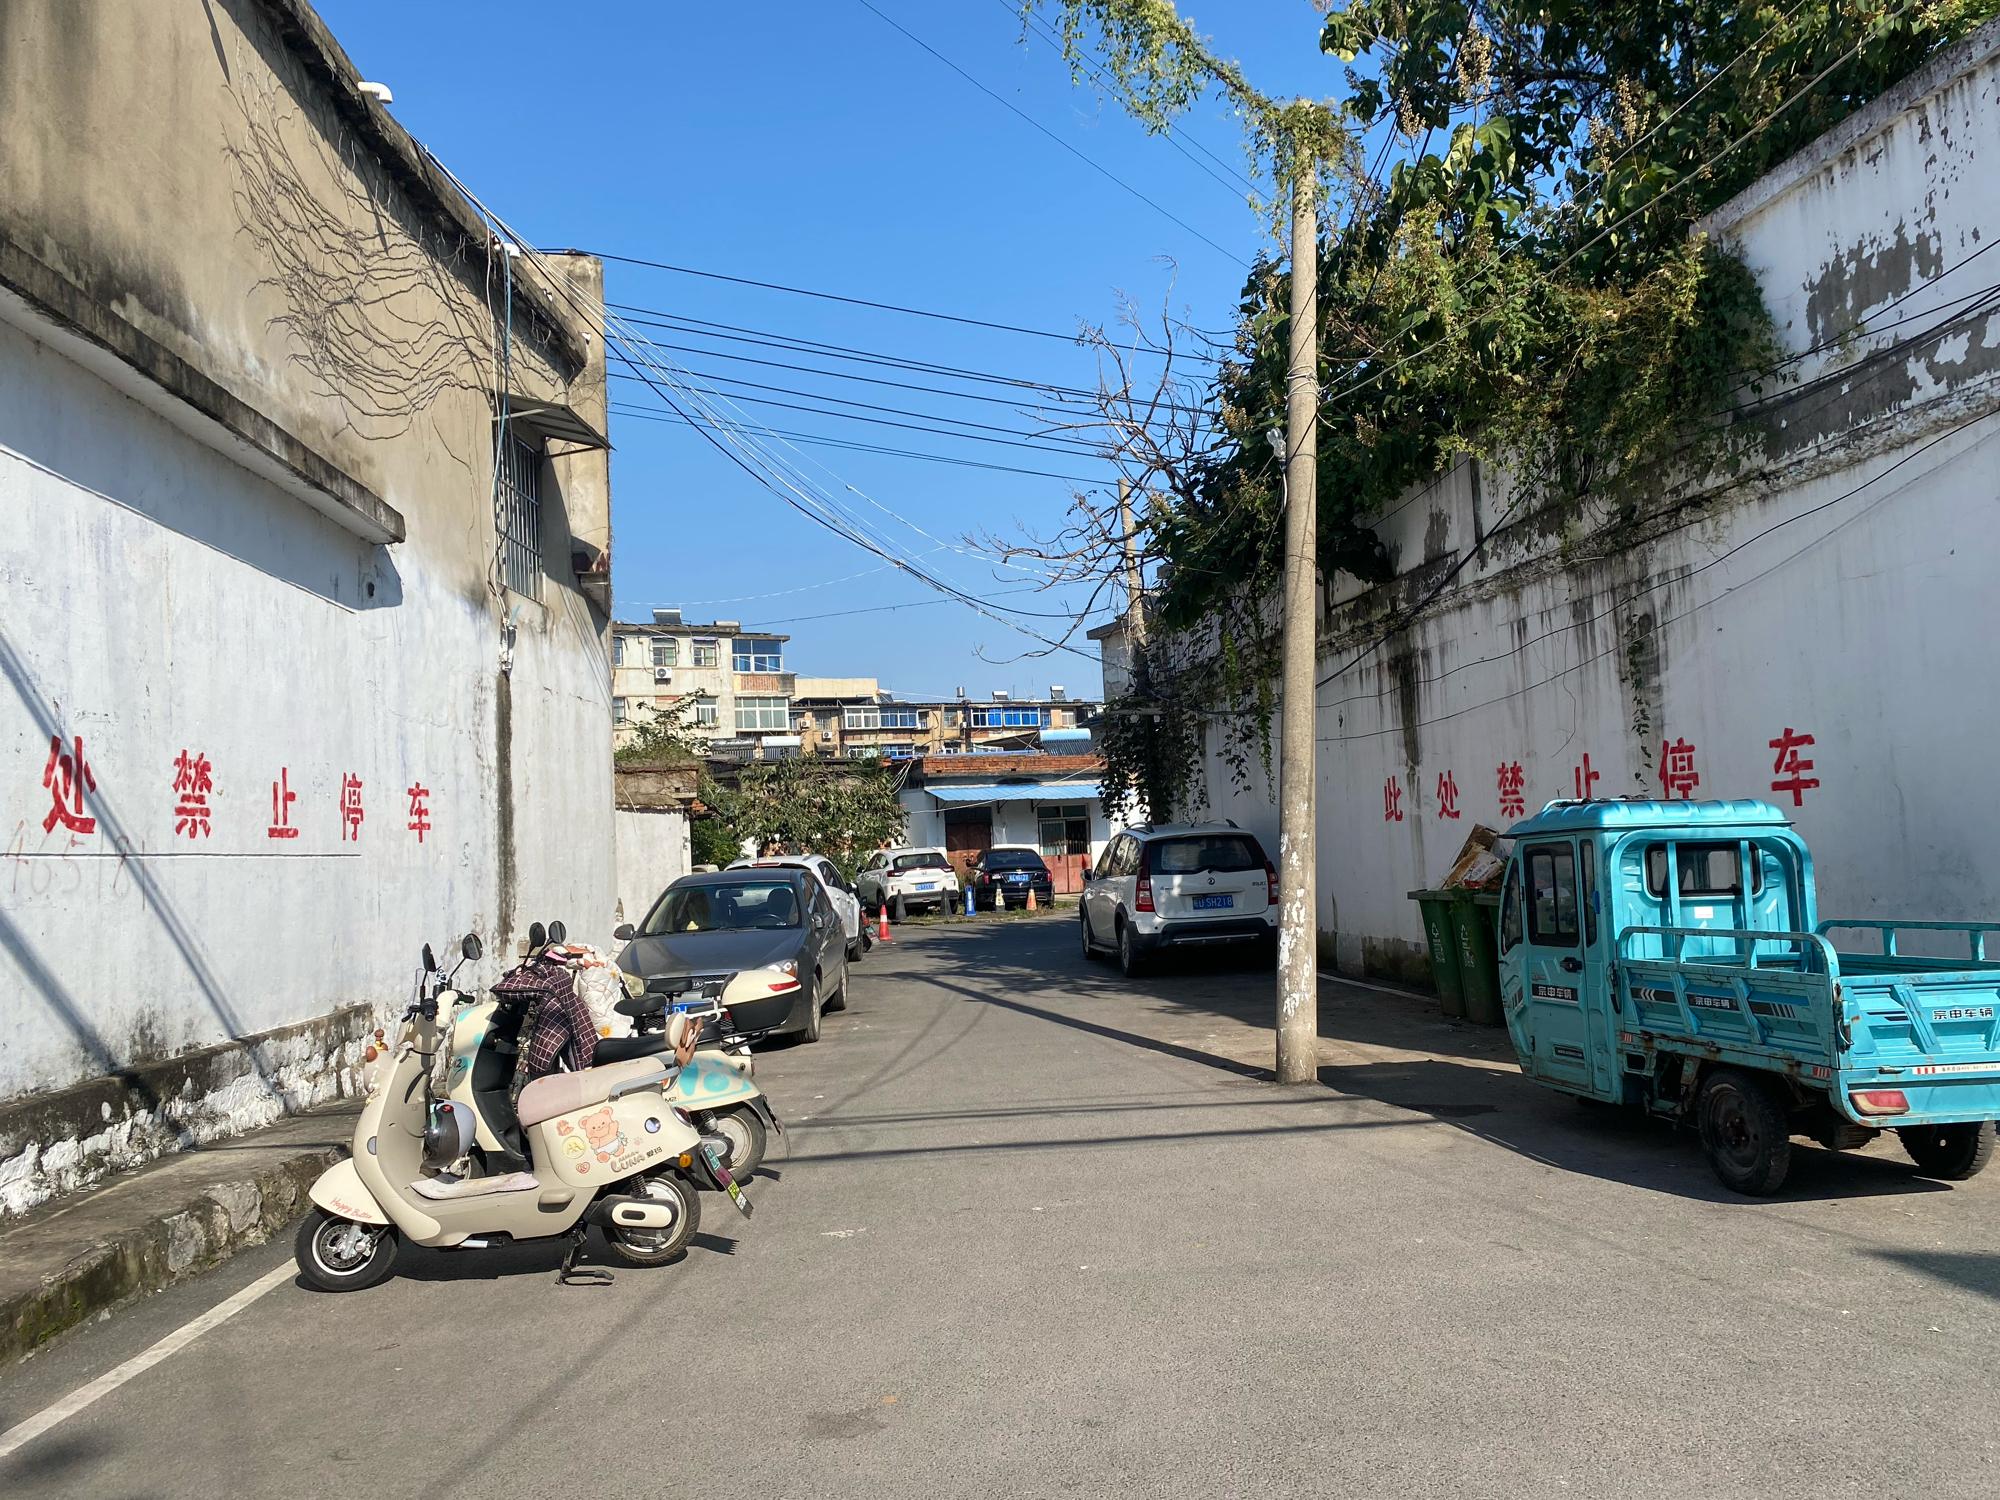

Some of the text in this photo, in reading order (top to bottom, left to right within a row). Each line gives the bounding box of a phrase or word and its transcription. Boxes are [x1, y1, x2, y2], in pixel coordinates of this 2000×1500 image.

[1384, 727, 1820, 822] 此处禁止停车
[42, 735, 431, 843] 处禁止停车
[1538, 986, 1572, 999] 宗申车辆
[1695, 996, 1730, 1009] 宗申车辆
[1933, 1007, 1993, 1020] 宗申车辆
[610, 1153, 646, 1173] LUNA
